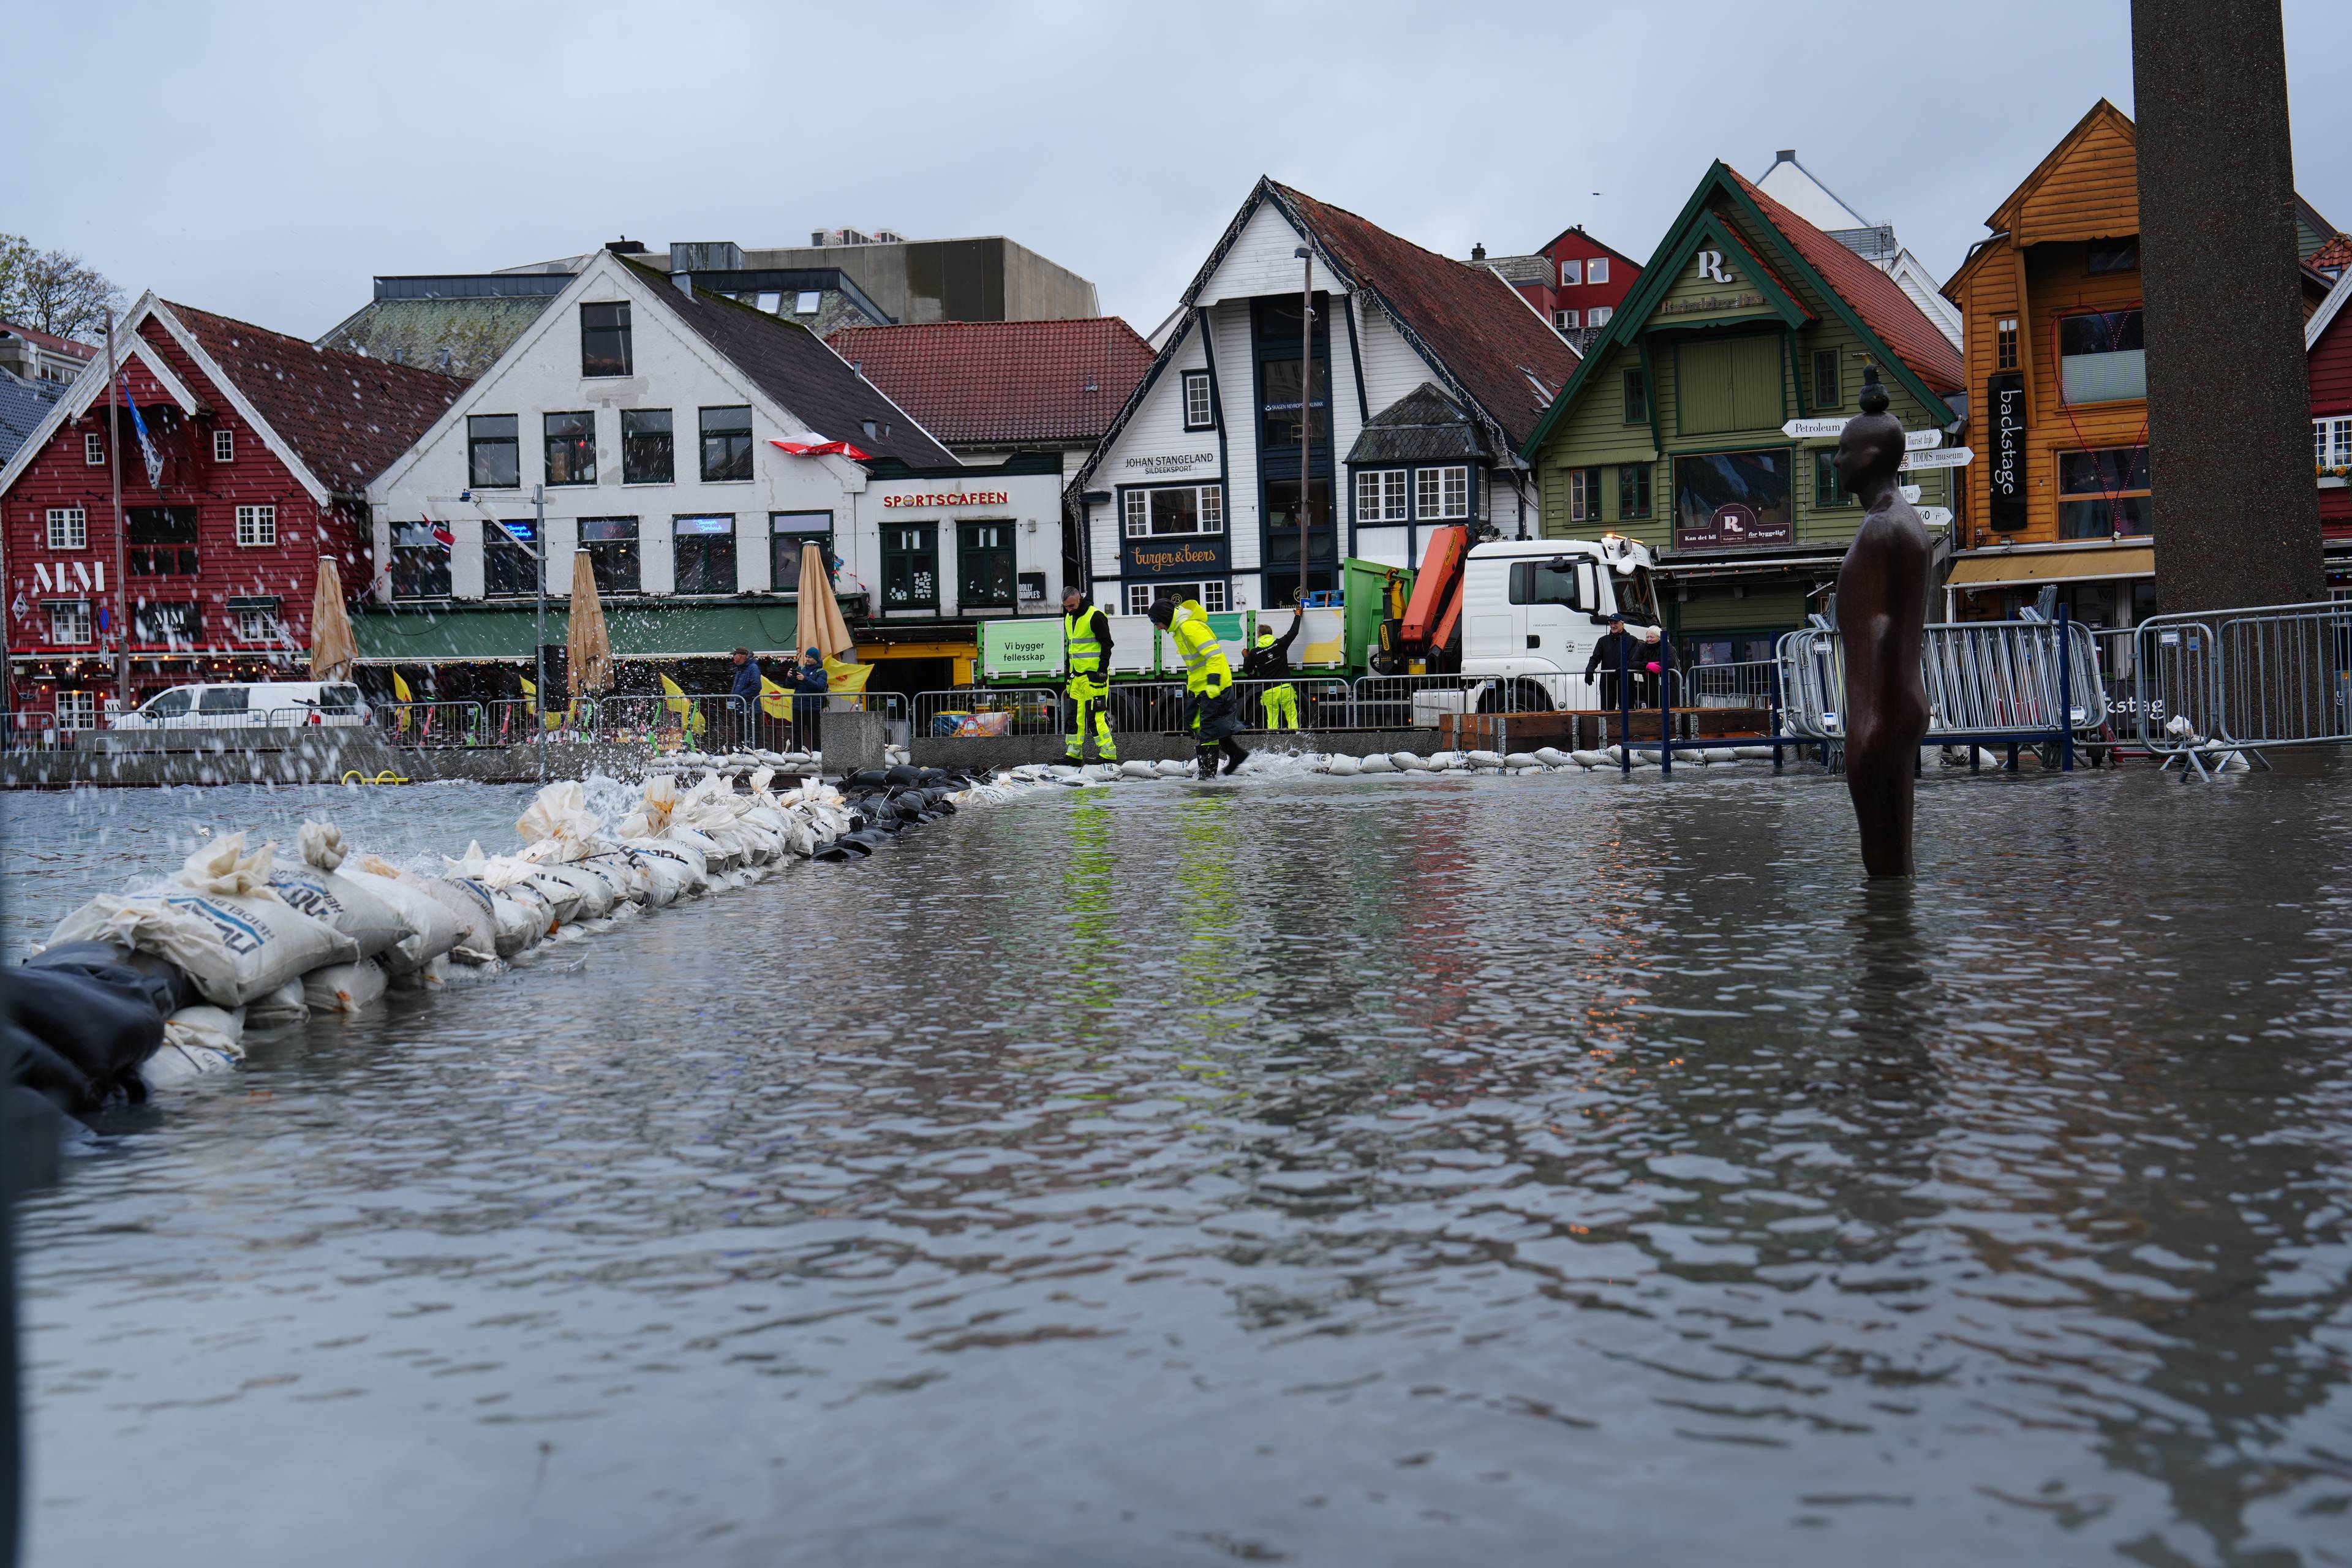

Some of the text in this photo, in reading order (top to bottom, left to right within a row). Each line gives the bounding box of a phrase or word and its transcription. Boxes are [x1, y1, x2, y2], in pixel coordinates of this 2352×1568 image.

[1697, 251, 1733, 283] R
[1795, 422, 1840, 432] Petroleum
[1907, 432, 1934, 446] Tourist Info
[1994, 390, 2023, 495] backstage
[1125, 453, 1213, 468] JOHAN STANGELAND
[1913, 452, 1933, 463] IDDIS
[1145, 465, 1192, 475] SILDEEKSPORT
[884, 492, 1008, 507] SPORTSCAFEEN
[1724, 516, 1744, 532] R
[1131, 544, 1216, 571] burger & beers
[34, 561, 105, 593] MM
[1019, 590, 1040, 599] DIMPLE'S
[1015, 642, 1044, 652] bygger
[1003, 653, 1045, 662] fellesskap
